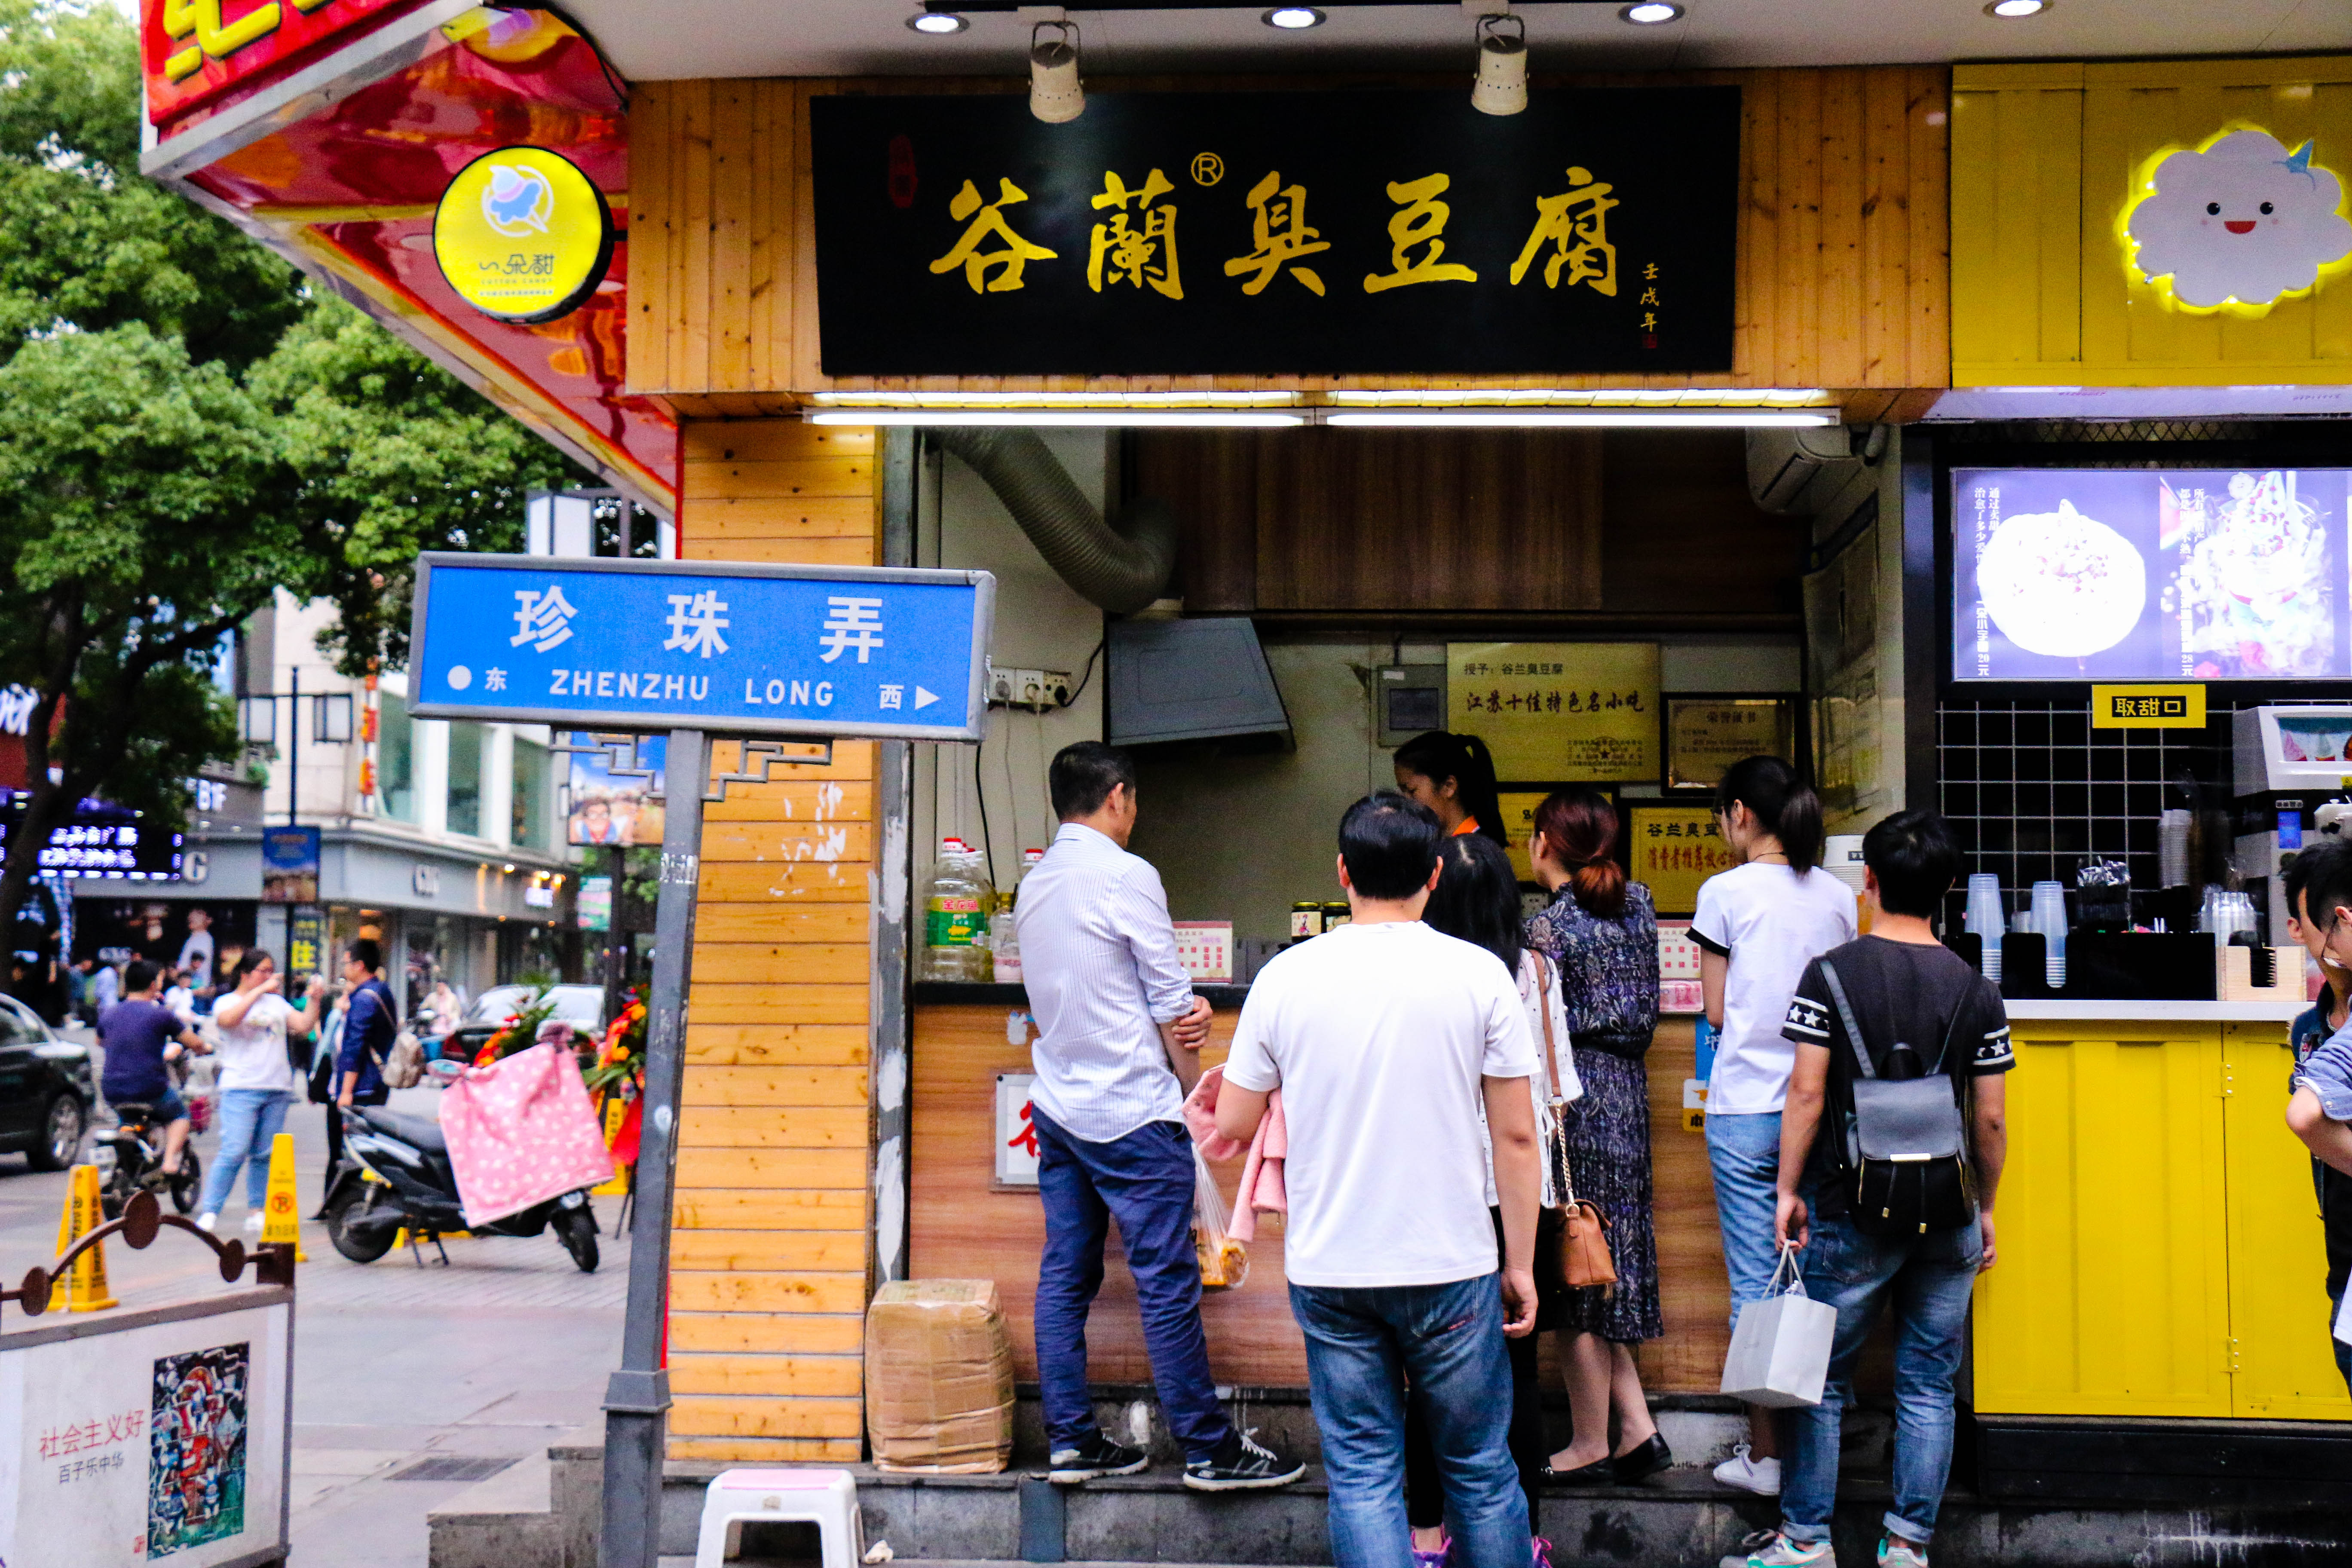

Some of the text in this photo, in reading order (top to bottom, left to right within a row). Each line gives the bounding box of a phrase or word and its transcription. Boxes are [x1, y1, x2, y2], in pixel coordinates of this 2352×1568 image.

[510, 585, 884, 664] 珍珠弄
[485, 667, 902, 710] 东 ZHENZHU LONG 西
[1467, 689, 1644, 713] 江苏十佳特色名小吃
[2115, 698, 2181, 716] 取甜口
[39, 1409, 144, 1461] 社会主义好
[58, 1451, 124, 1485] 百子乐中华
